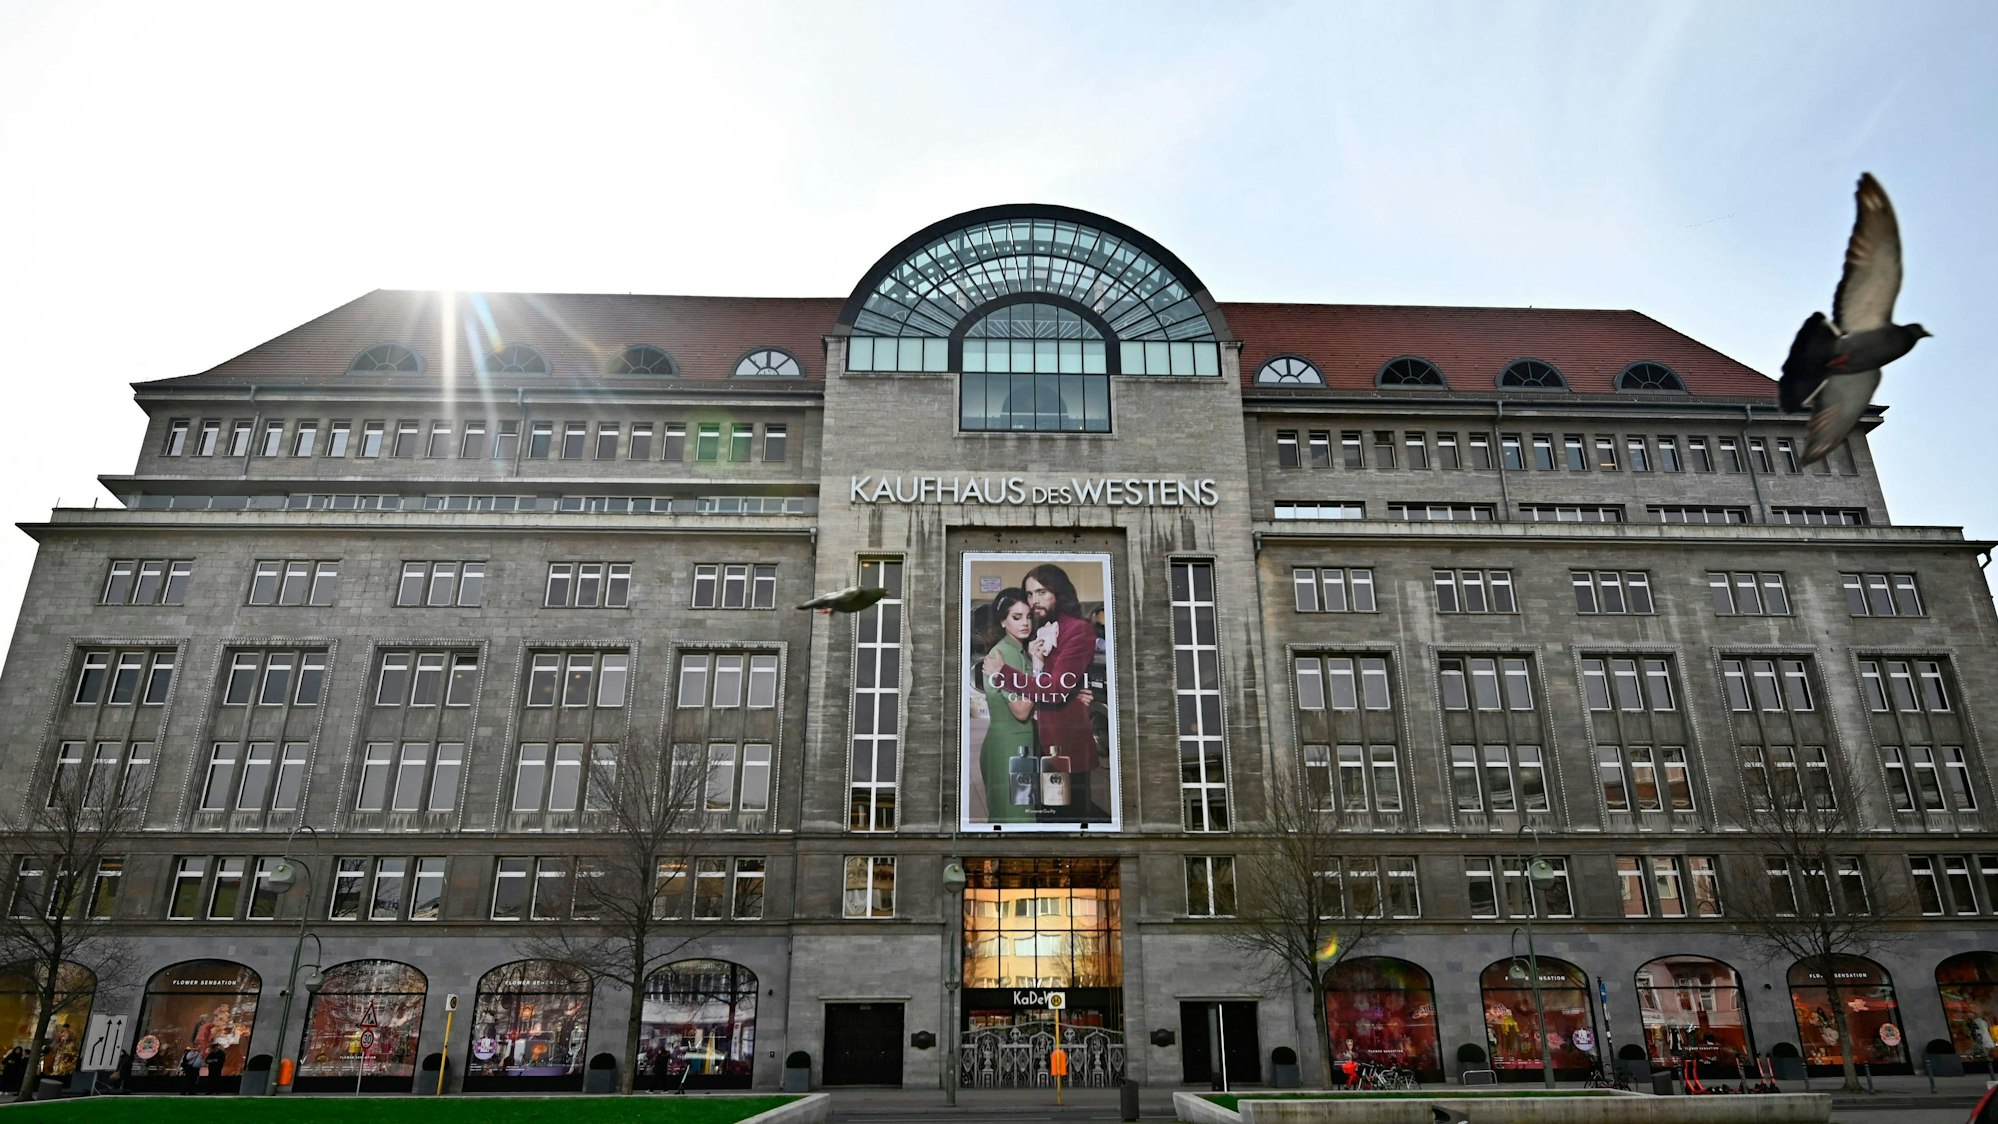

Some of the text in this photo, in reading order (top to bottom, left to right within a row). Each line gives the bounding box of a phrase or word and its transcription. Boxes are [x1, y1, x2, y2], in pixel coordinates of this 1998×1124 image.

[850, 475, 1220, 507] KAUFHAUS DES WESTENS
[988, 671, 1089, 689] GUCCI
[1007, 692, 1070, 703] GUILTY
[1013, 990, 1054, 1005] KaDeW
[362, 1034, 372, 1044] 30
